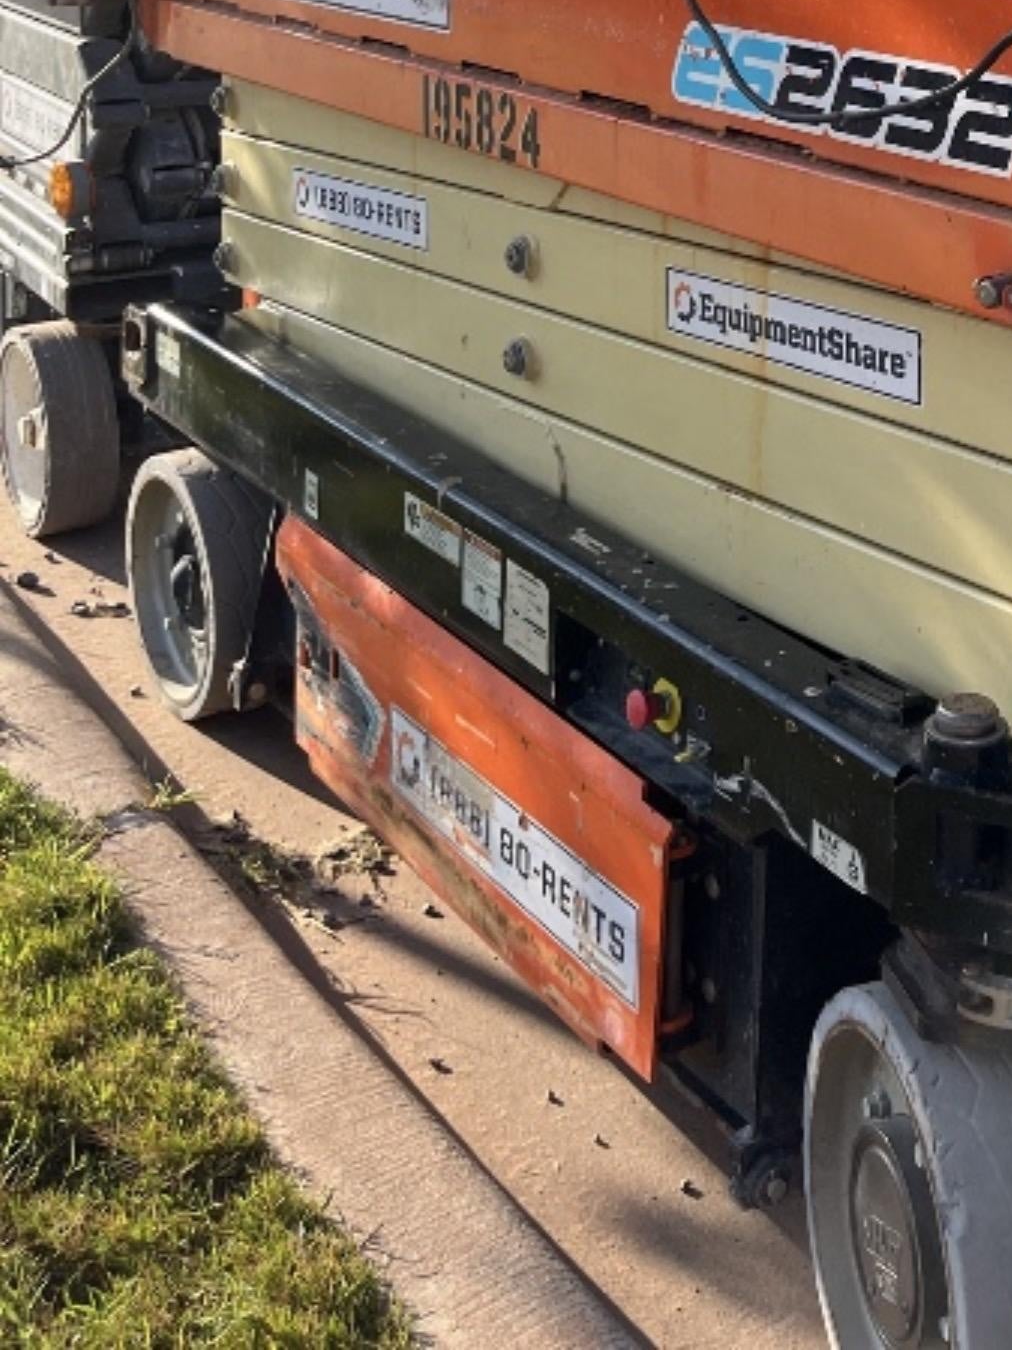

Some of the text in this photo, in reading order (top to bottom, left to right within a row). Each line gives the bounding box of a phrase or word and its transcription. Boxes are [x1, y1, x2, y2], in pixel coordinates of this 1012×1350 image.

[423, 74, 541, 169] 195824
[699, 291, 906, 378] EquipmentShare
[499, 826, 625, 964] 80-RENTS
